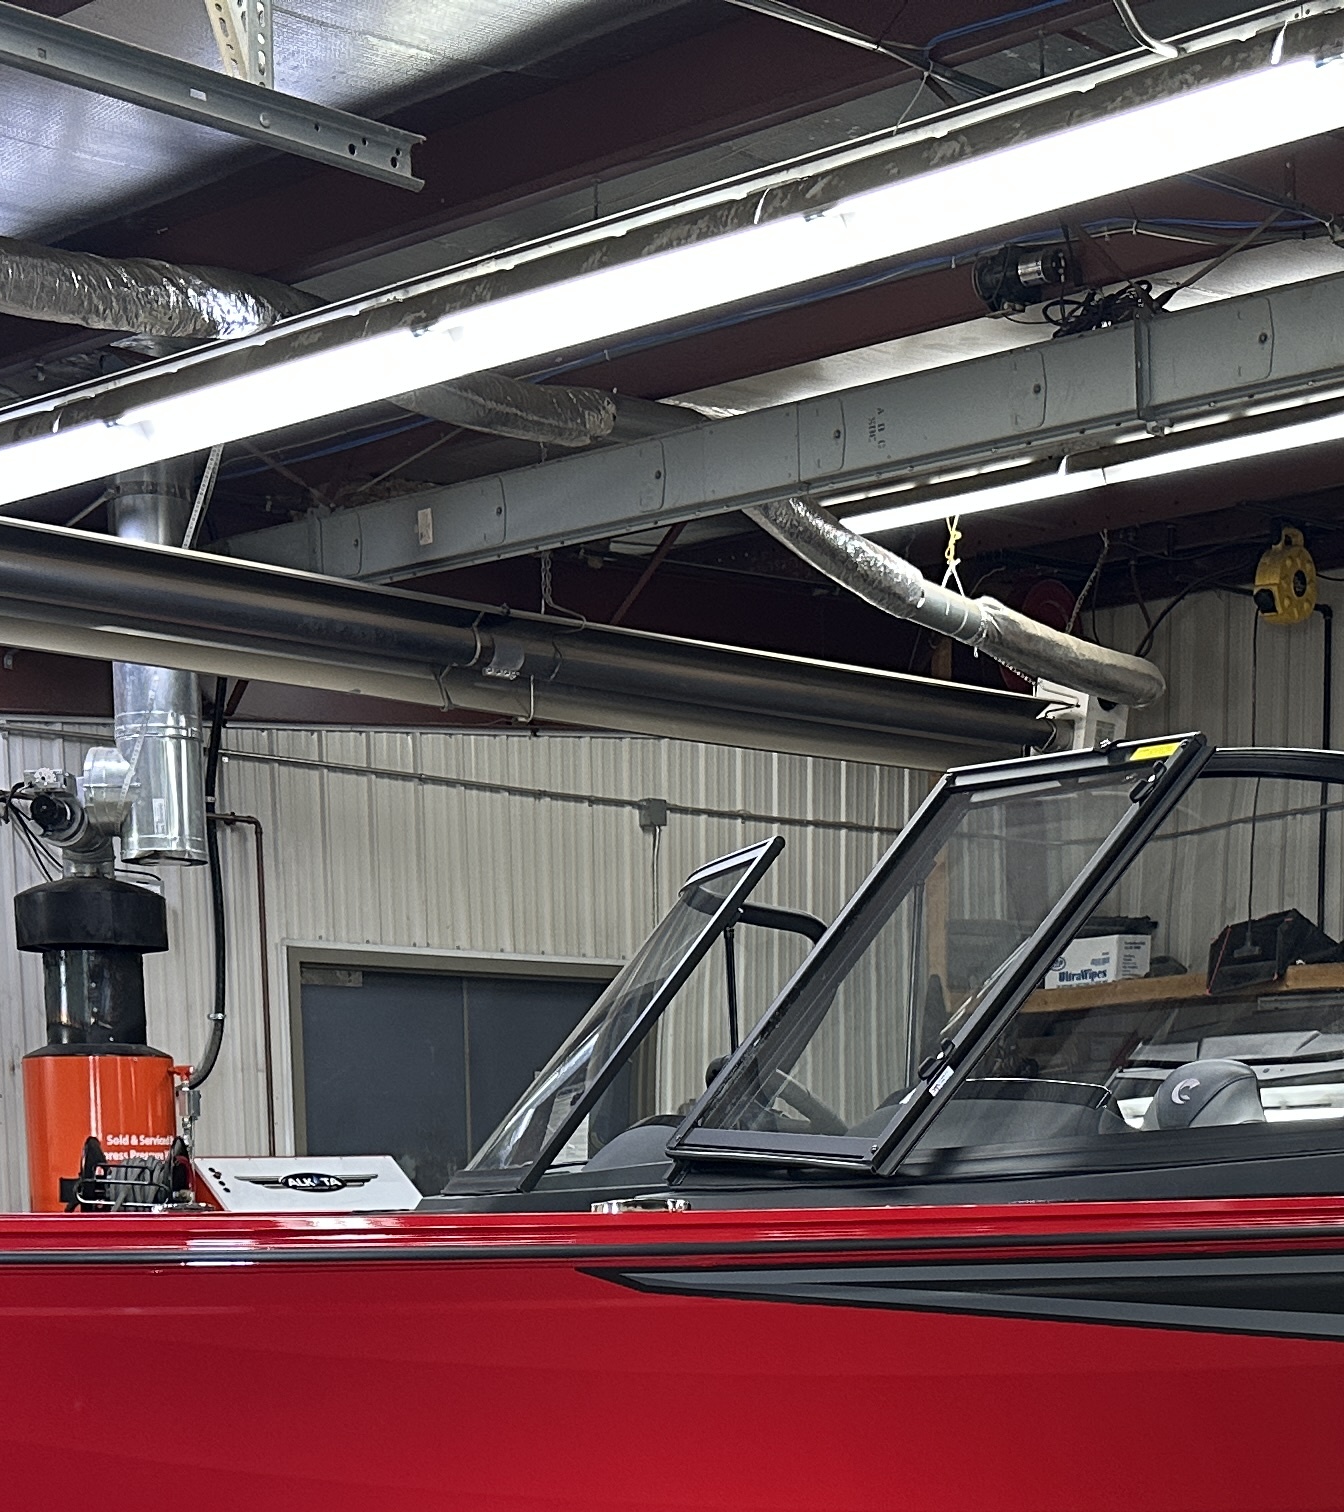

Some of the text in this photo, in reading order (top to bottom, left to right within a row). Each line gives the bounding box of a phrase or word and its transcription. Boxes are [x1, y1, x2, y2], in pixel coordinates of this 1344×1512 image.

[1058, 968, 1108, 983] UltraWipes
[106, 1134, 129, 1146] Sold
[130, 1134, 138, 1146] &
